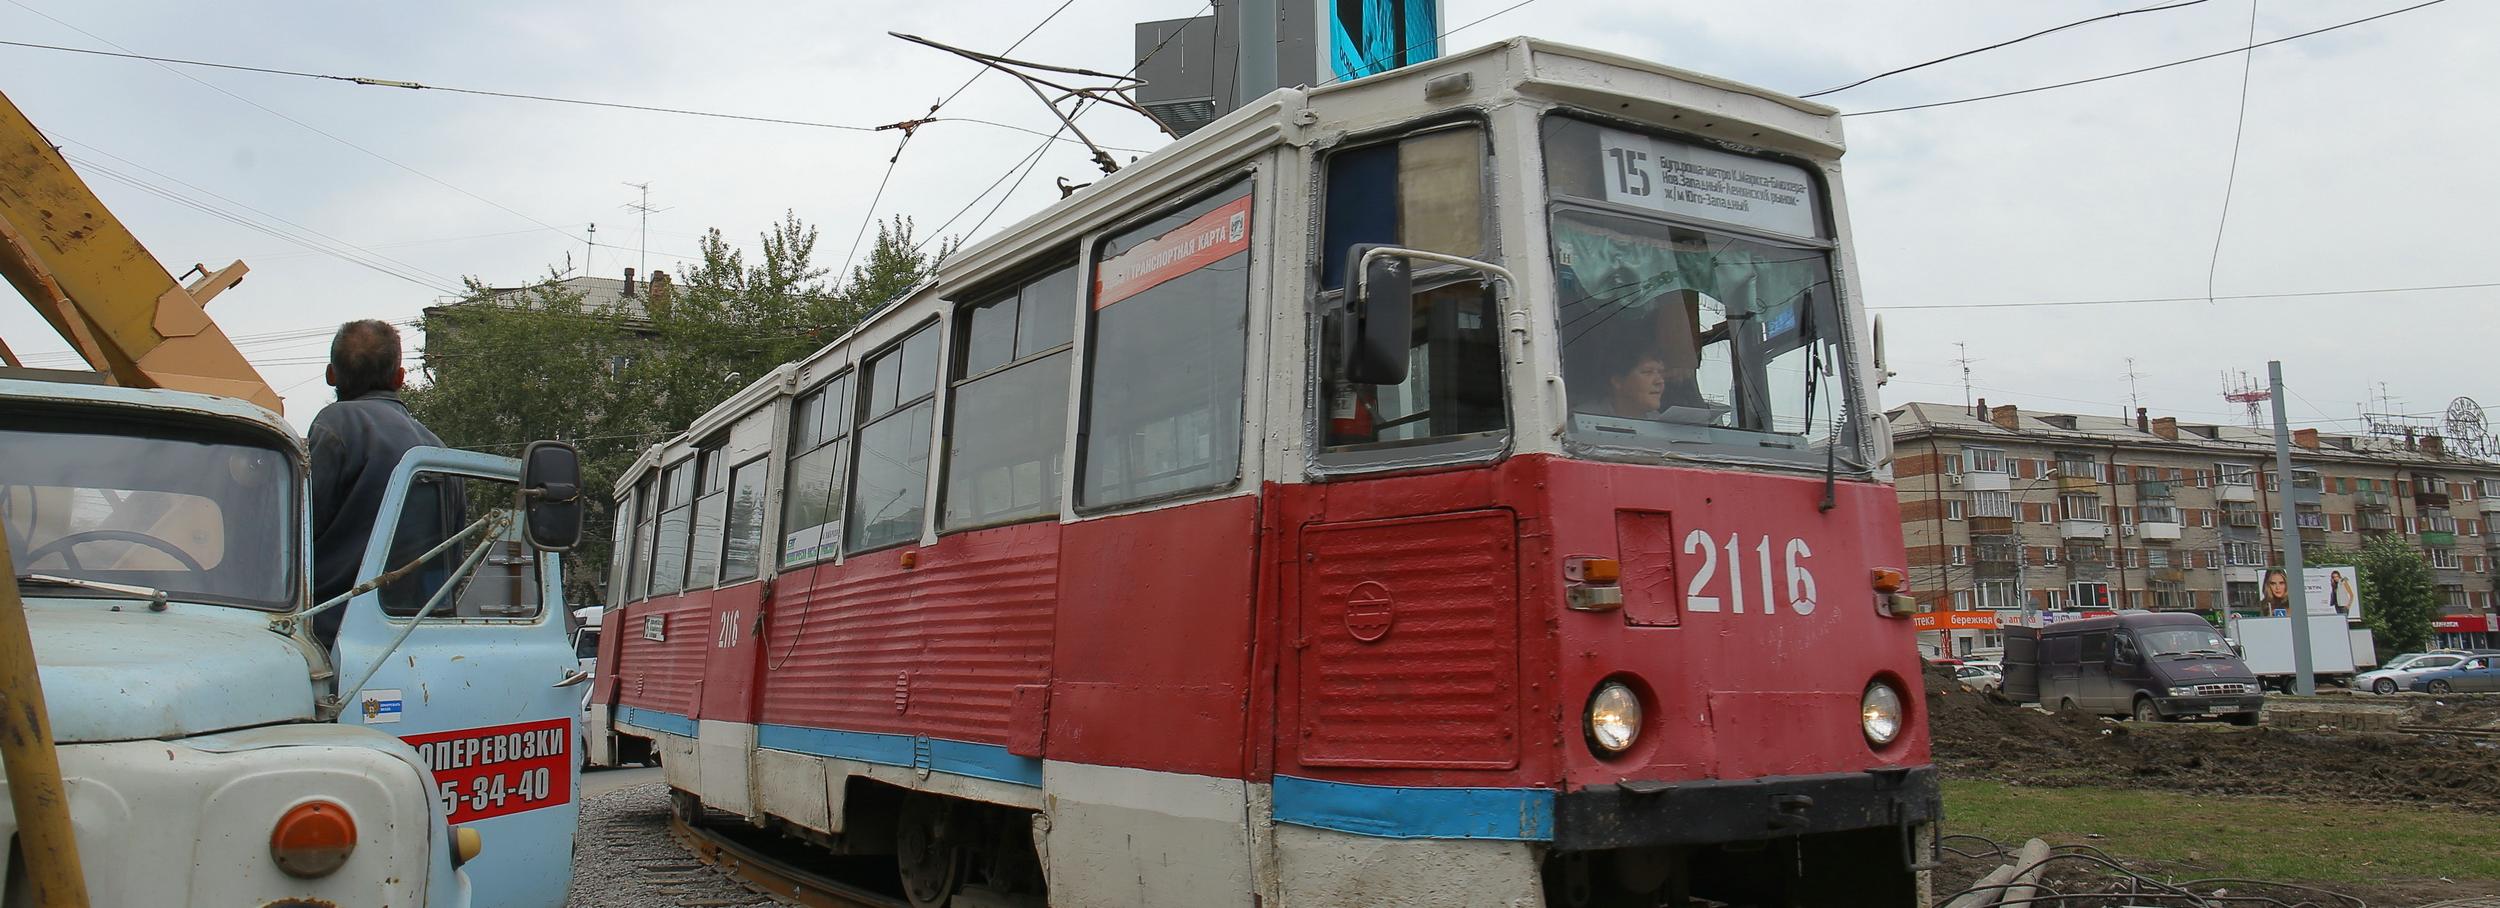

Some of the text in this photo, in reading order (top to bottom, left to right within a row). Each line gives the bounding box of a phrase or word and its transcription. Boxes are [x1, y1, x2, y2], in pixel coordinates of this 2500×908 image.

[1608, 148, 1651, 197] 15
[1131, 240, 1195, 279] ТРАНСПОРТНАЯ
[1197, 226, 1226, 251] КАРТА
[1684, 529, 1817, 616] 2116
[718, 609, 740, 648] 2116
[1951, 615, 1993, 626] бережная
[2008, 616, 2036, 624] аптка
[441, 767, 549, 816] 5-34-40
